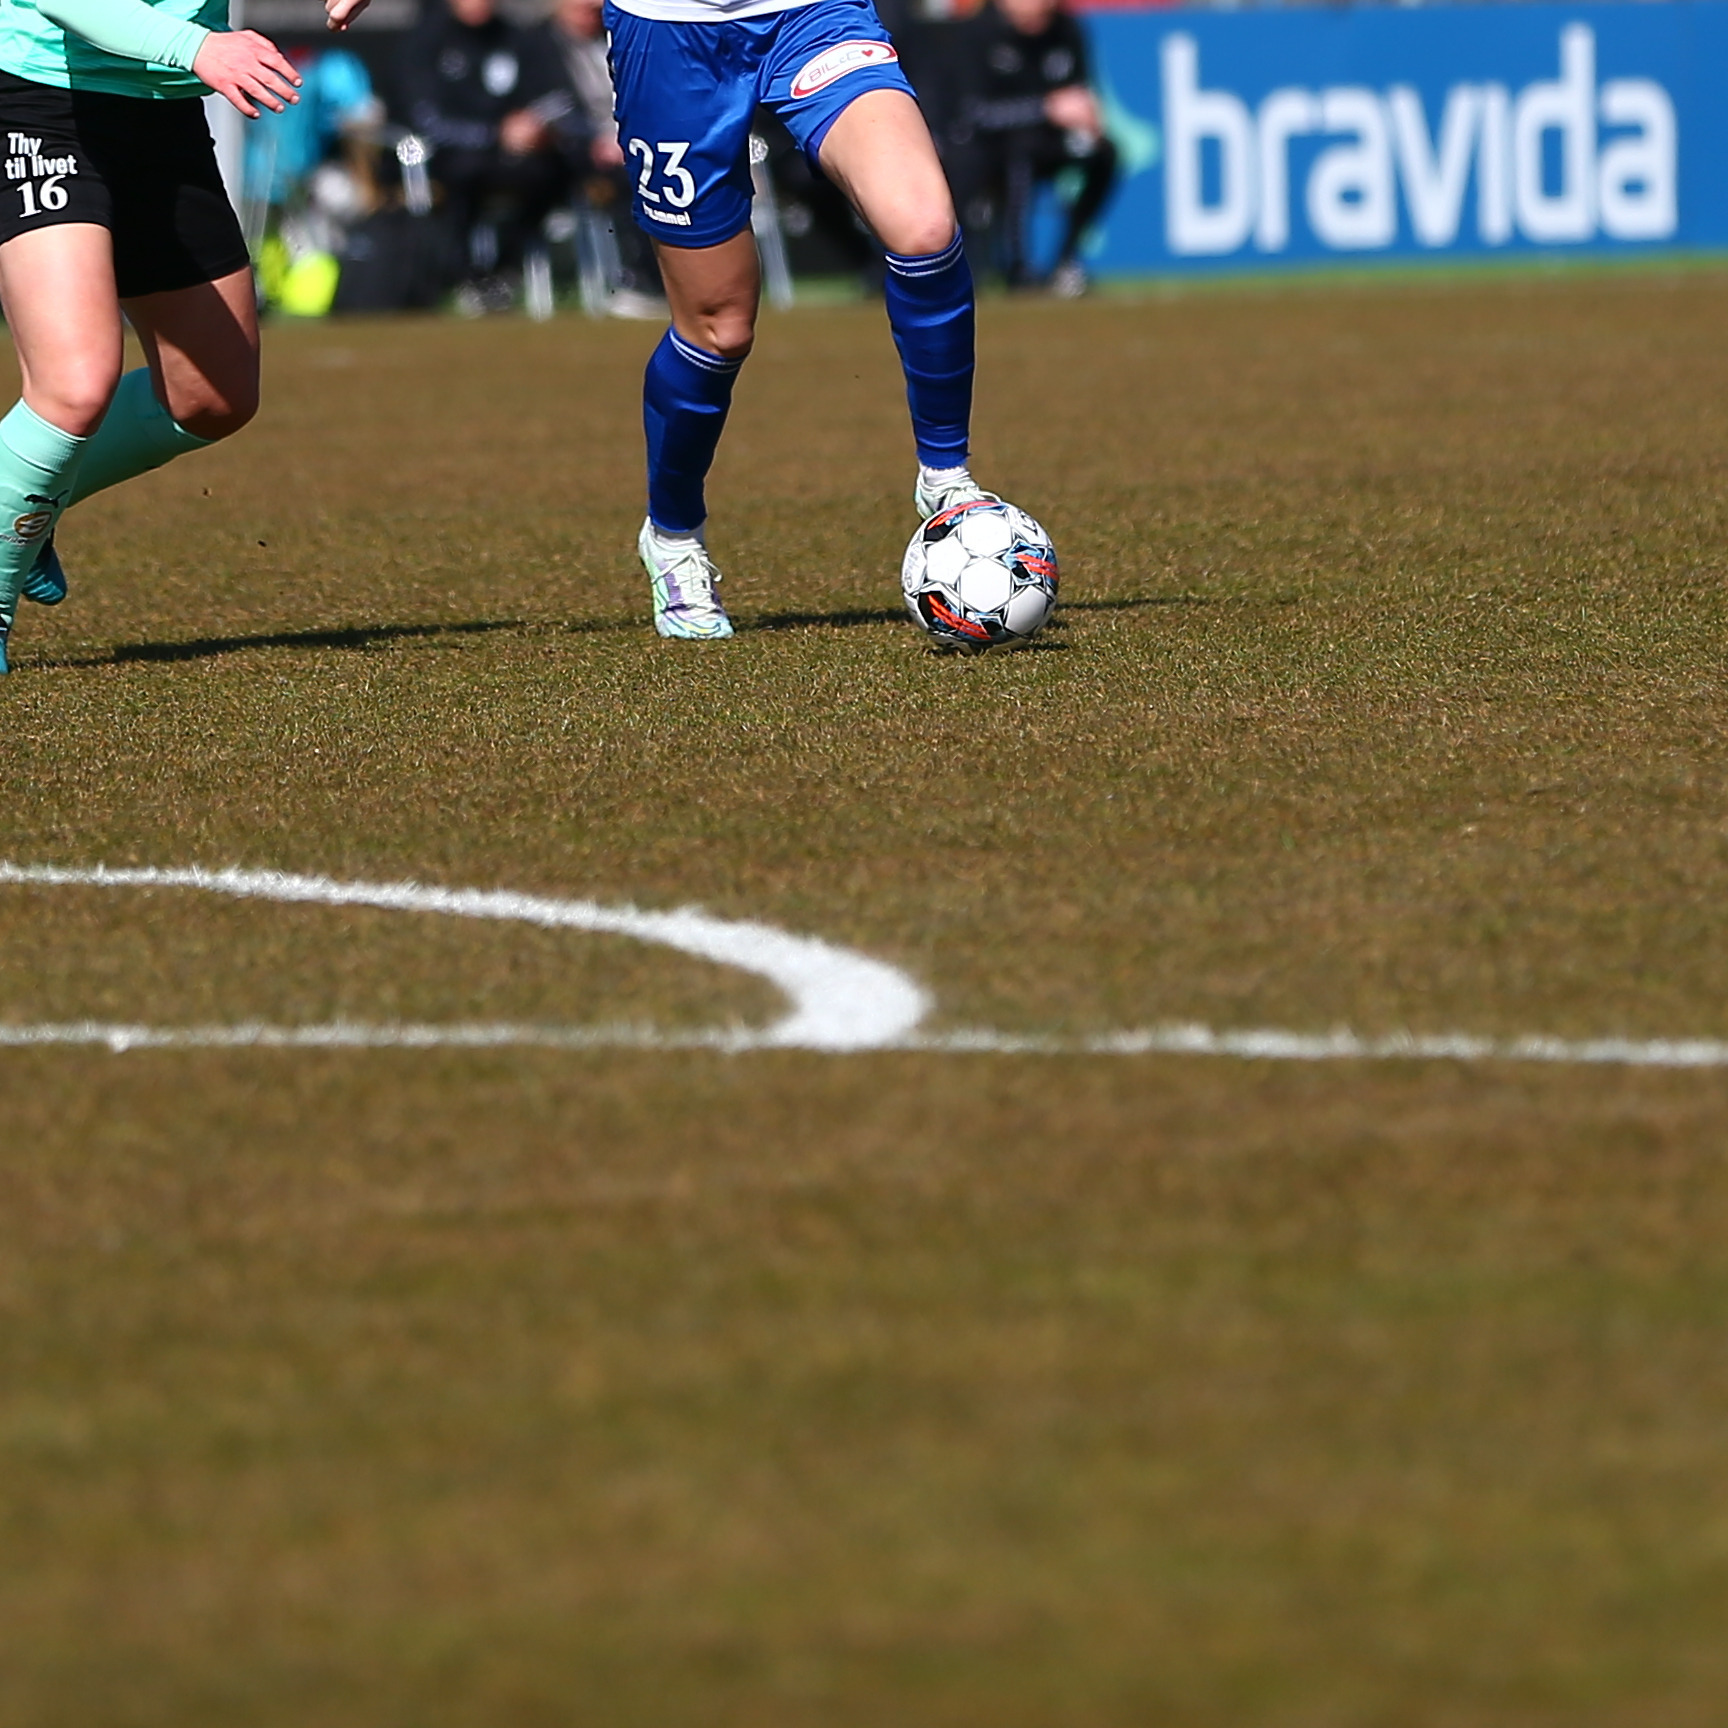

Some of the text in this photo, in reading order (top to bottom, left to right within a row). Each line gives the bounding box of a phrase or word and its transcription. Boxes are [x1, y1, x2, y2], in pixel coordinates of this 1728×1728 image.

[7, 132, 43, 158] Thy
[1161, 21, 1678, 255] bravida
[4, 154, 79, 180] til livet
[628, 137, 696, 209] 23
[16, 174, 69, 219] 16
